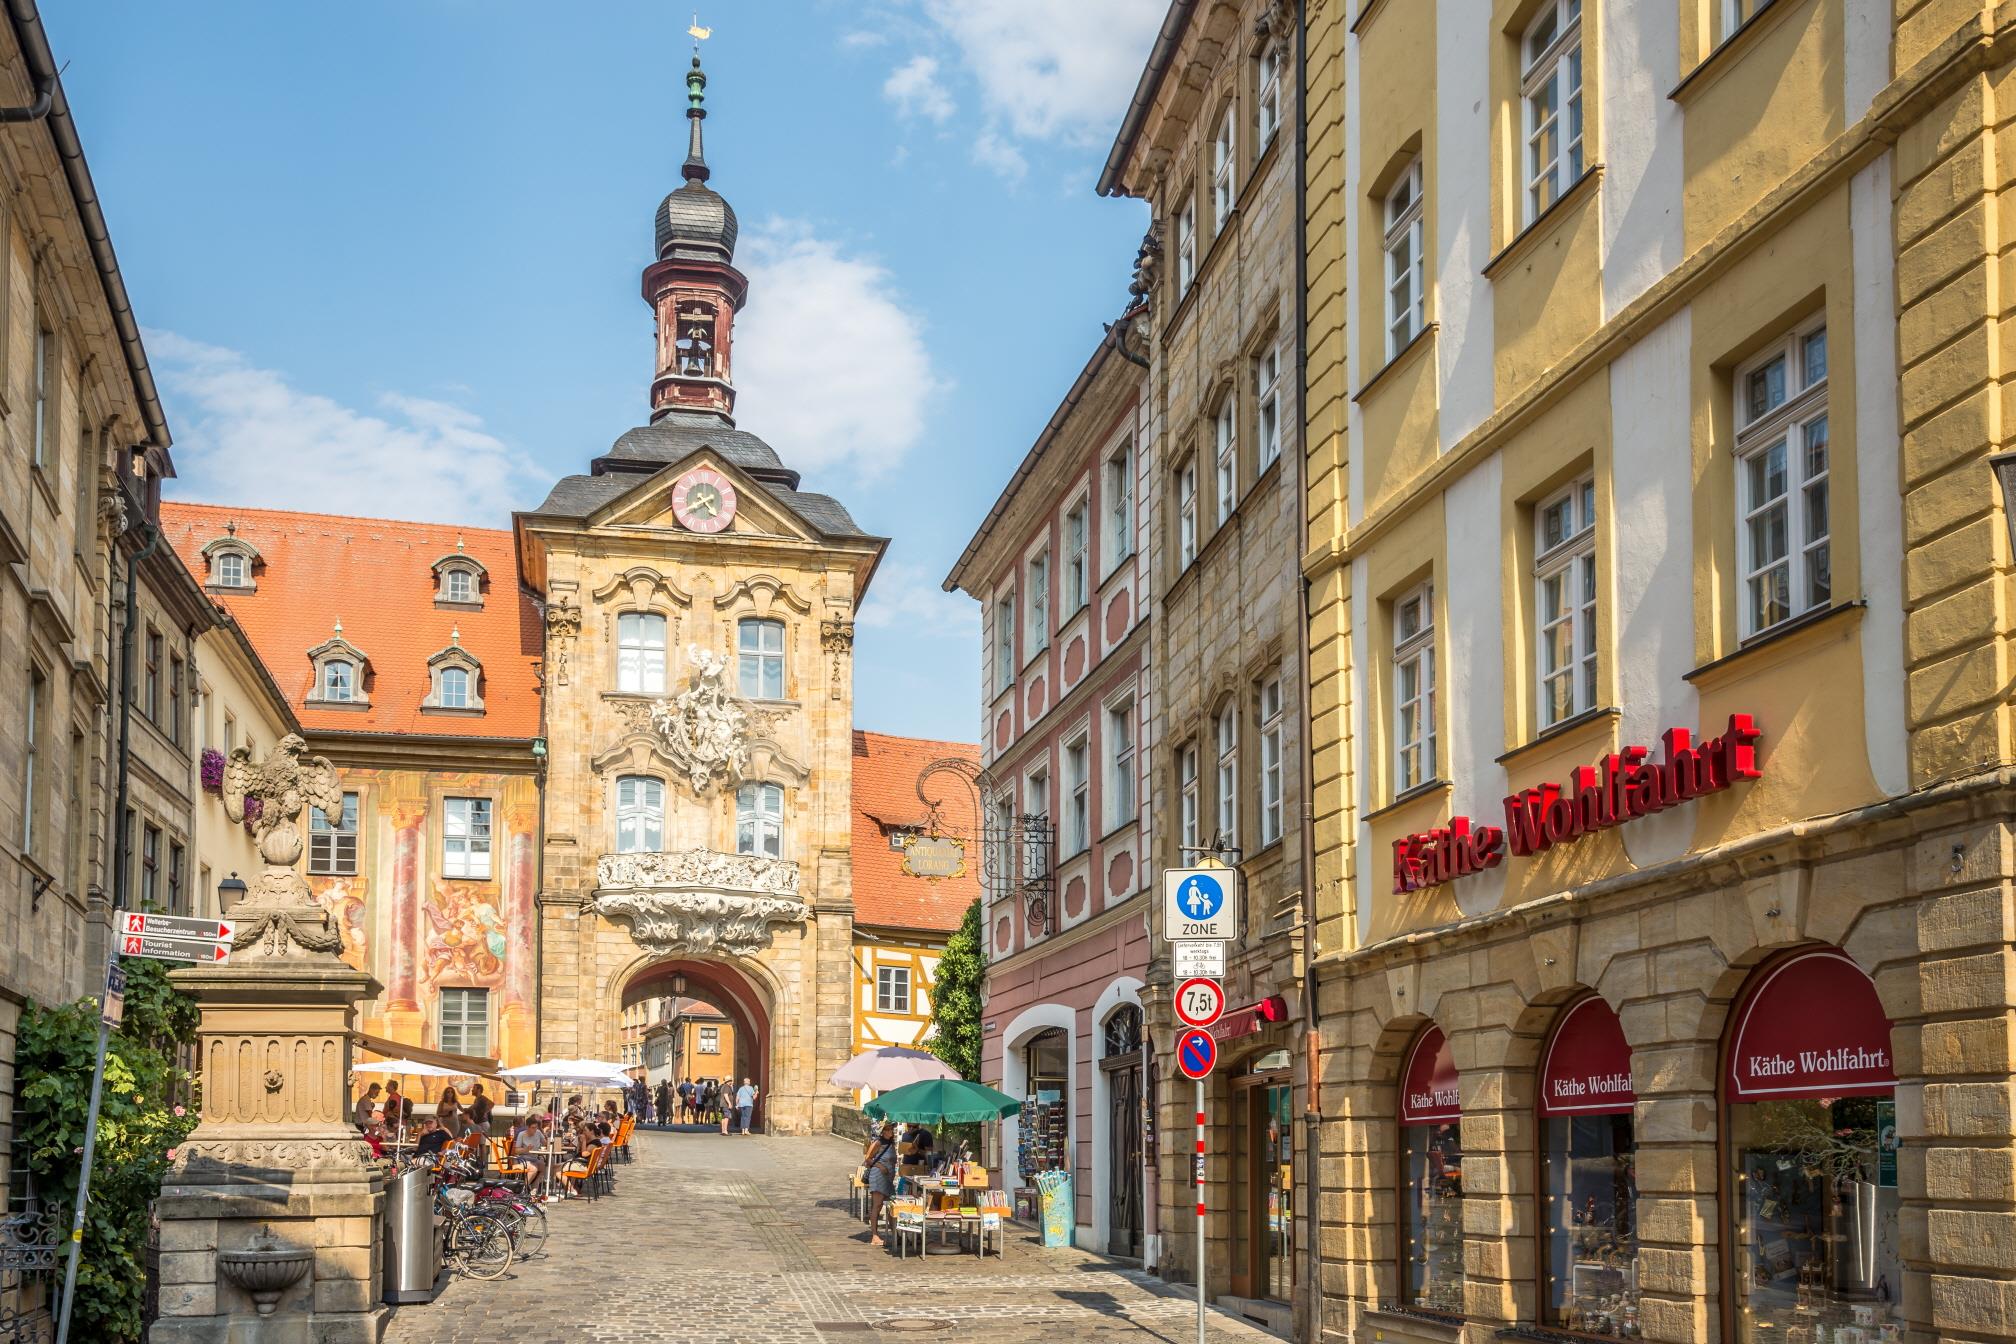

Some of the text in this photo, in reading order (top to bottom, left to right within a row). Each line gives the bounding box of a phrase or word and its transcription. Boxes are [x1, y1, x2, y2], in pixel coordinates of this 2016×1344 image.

[1503, 713, 1763, 856] Wohlfahrt
[145, 925, 197, 936] Besucherzentrum
[1182, 923, 1218, 935] ZONE
[143, 940, 173, 949] Tourist
[142, 947, 191, 958] Information
[1187, 992, 1212, 1016] 7,5t
[1750, 1054, 1796, 1076] Käthe
[1554, 1077, 1586, 1096] Käthe
[1411, 1093, 1433, 1108] Käthe
